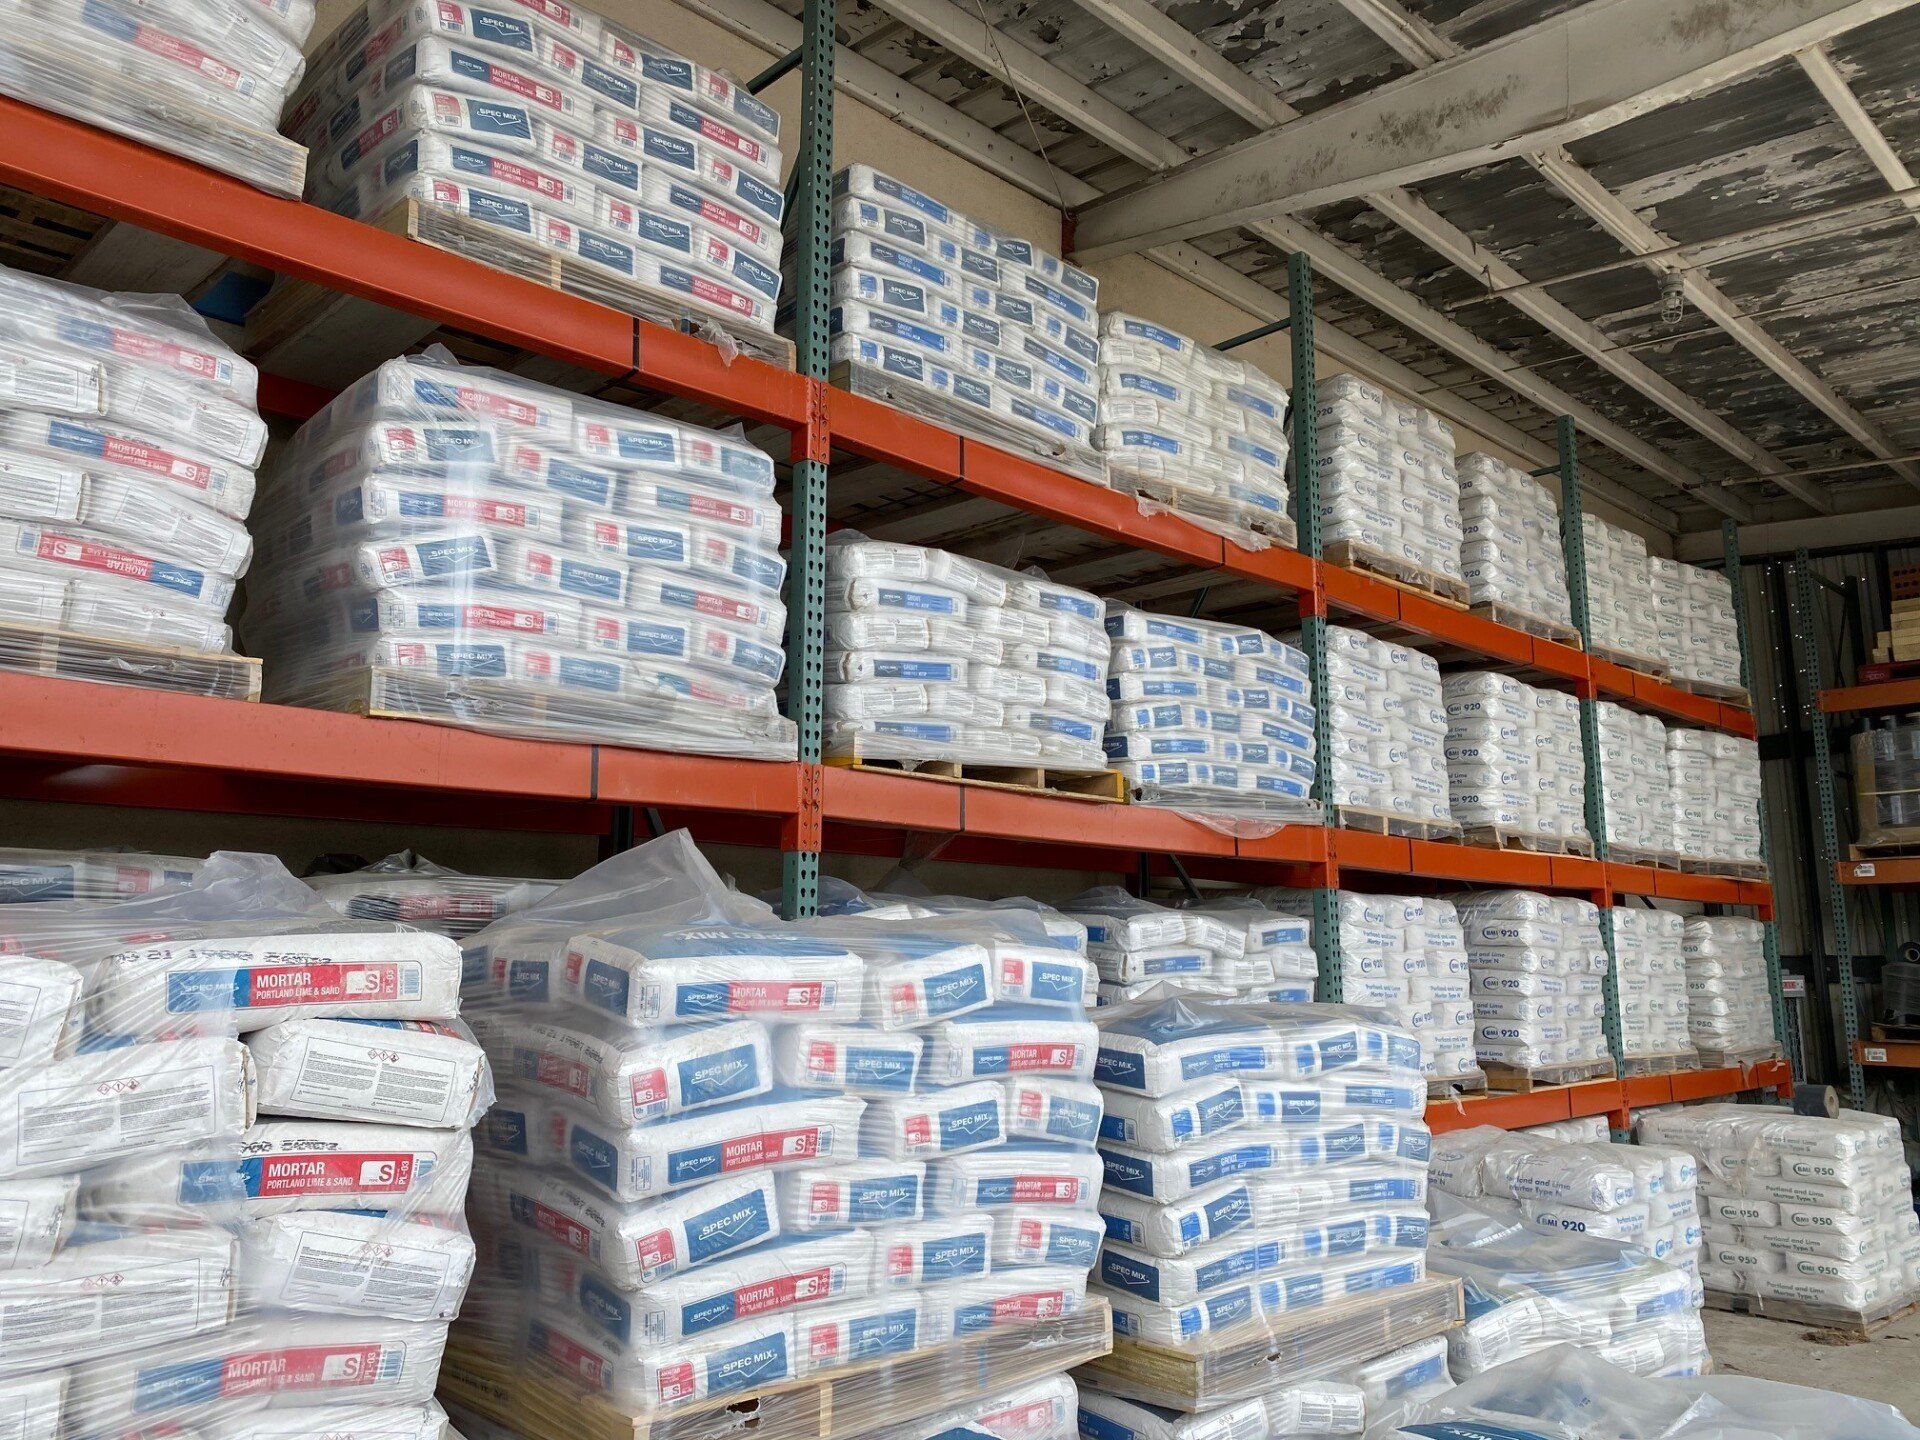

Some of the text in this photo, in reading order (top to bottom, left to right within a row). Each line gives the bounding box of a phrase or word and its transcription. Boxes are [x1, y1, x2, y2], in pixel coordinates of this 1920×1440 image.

[482, 17, 520, 31] SPEC MIX
[492, 68, 520, 83] MORTAR
[669, 65, 682, 74] MIX
[593, 69, 628, 91] SPEC MIX
[480, 108, 517, 120] SPEC MIX
[704, 120, 726, 135] MORTAR
[653, 136, 686, 151] SPEC MIX
[493, 161, 521, 175] MORTAR
[594, 153, 629, 170] SPEC MIX
[746, 180, 775, 203] SPEC MIX
[480, 198, 520, 213] SPEC MIX
[703, 202, 727, 217] MORTAR
[649, 219, 681, 235] SPEC MIX
[589, 238, 624, 255] SPEC MIX
[743, 261, 772, 281] SPEC MIX
[694, 278, 717, 293] MORTAR
[648, 438, 663, 447] MIX
[109, 442, 148, 458] MORTAR
[185, 466, 195, 478] S
[1464, 525, 1479, 534] 920
[658, 537, 673, 545] MIX
[107, 559, 147, 576] MORTAR
[744, 558, 774, 573] SPEC MIX
[572, 569, 610, 582] SPEC MIX
[1464, 569, 1480, 577] 920
[477, 652, 493, 660] MIX
[1464, 703, 1480, 711] 920
[32, 877, 57, 885] MIX
[1501, 929, 1518, 938] 920
[257, 973, 311, 987] MORTAR
[365, 973, 378, 990] S
[593, 974, 620, 989] SPEC MIX
[1042, 973, 1075, 982] SPEC MIX
[1502, 979, 1519, 988] 920
[256, 989, 294, 999] PORTLAND
[295, 988, 312, 997] LIME
[321, 986, 339, 995] SAND
[936, 978, 974, 994] SPEC MIX
[733, 988, 766, 998] MORTAR
[799, 991, 809, 1004] S
[1501, 1029, 1519, 1037] 920
[859, 1060, 900, 1069] SPEC MIX
[1099, 1057, 1117, 1068] SPEC
[695, 1060, 743, 1080] SPEC MIX
[951, 1114, 989, 1128] SPEC MIX
[727, 1141, 762, 1157] MORTAR
[795, 1138, 804, 1151] S
[578, 1142, 608, 1162] SPEC MIX
[269, 1162, 325, 1177] MORTAR
[378, 1164, 392, 1183] S
[399, 1161, 409, 1184] PL-03
[1106, 1161, 1140, 1175] SPEC MIX
[1438, 1170, 1453, 1178] Lime
[1814, 1168, 1835, 1176] 950
[267, 1179, 305, 1189] PORTLAND
[307, 1178, 325, 1187] LIME
[332, 1177, 353, 1186] SAND
[1016, 1182, 1041, 1190] MORTAR
[863, 1188, 906, 1199] SPEC MIX
[1535, 1187, 1554, 1198] Type
[703, 1208, 751, 1235] SPEC MIX
[1562, 1220, 1586, 1233] 920
[1077, 1240, 1091, 1248] MIX
[935, 1247, 974, 1259] SPEC MIX
[1738, 1256, 1757, 1264] 950
[1111, 1263, 1146, 1280] SPEC MIX
[1818, 1267, 1839, 1275] 950
[808, 1280, 817, 1293] S
[1767, 1281, 1793, 1290] Portland
[605, 1303, 619, 1316] MIX
[693, 1305, 726, 1320] SPEC MIX
[863, 1324, 904, 1337] SPEC MIX
[723, 1350, 773, 1372] SPEC MIX
[228, 1358, 286, 1378] MORTAR
[342, 1358, 358, 1378] S
